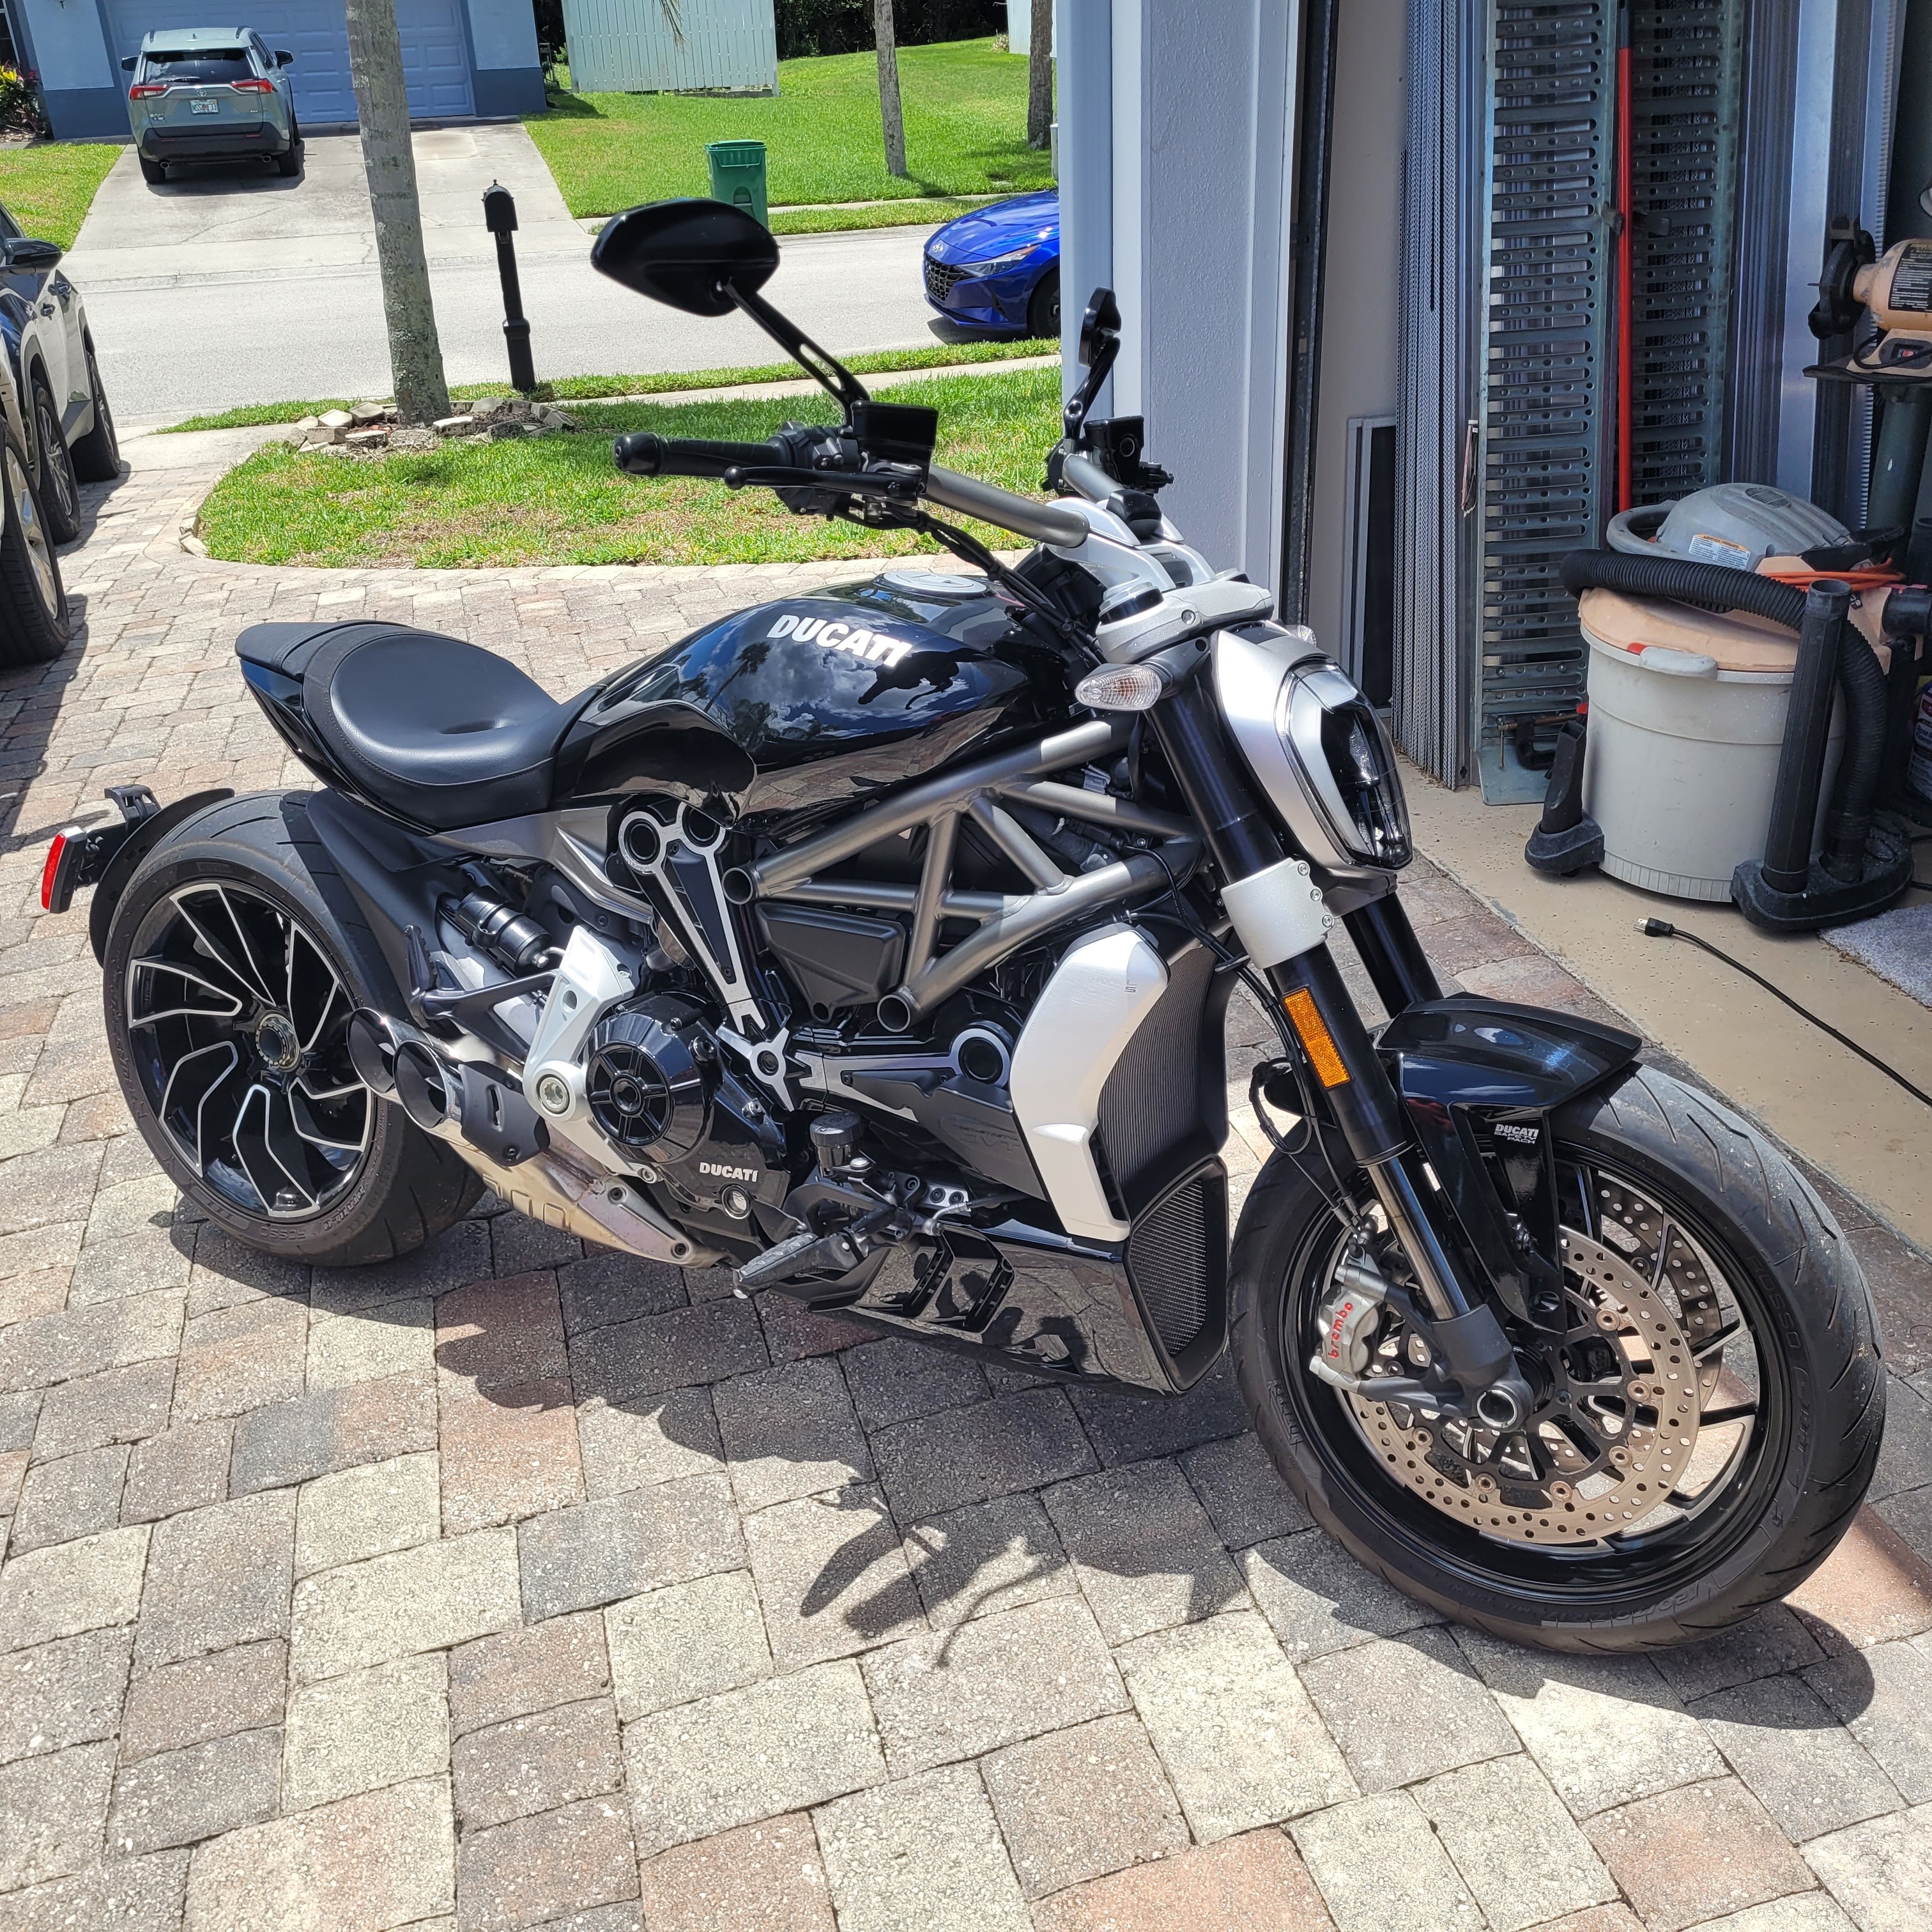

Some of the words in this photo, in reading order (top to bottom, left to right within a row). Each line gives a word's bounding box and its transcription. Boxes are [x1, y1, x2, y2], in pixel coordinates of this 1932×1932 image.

[766, 614, 913, 667] DUCATI
[1494, 1131, 1537, 1140] SAFETY
[1495, 1123, 1539, 1137] DUCATI
[699, 1162, 758, 1183] DUCATI
[1328, 1302, 1353, 1359] brembo
